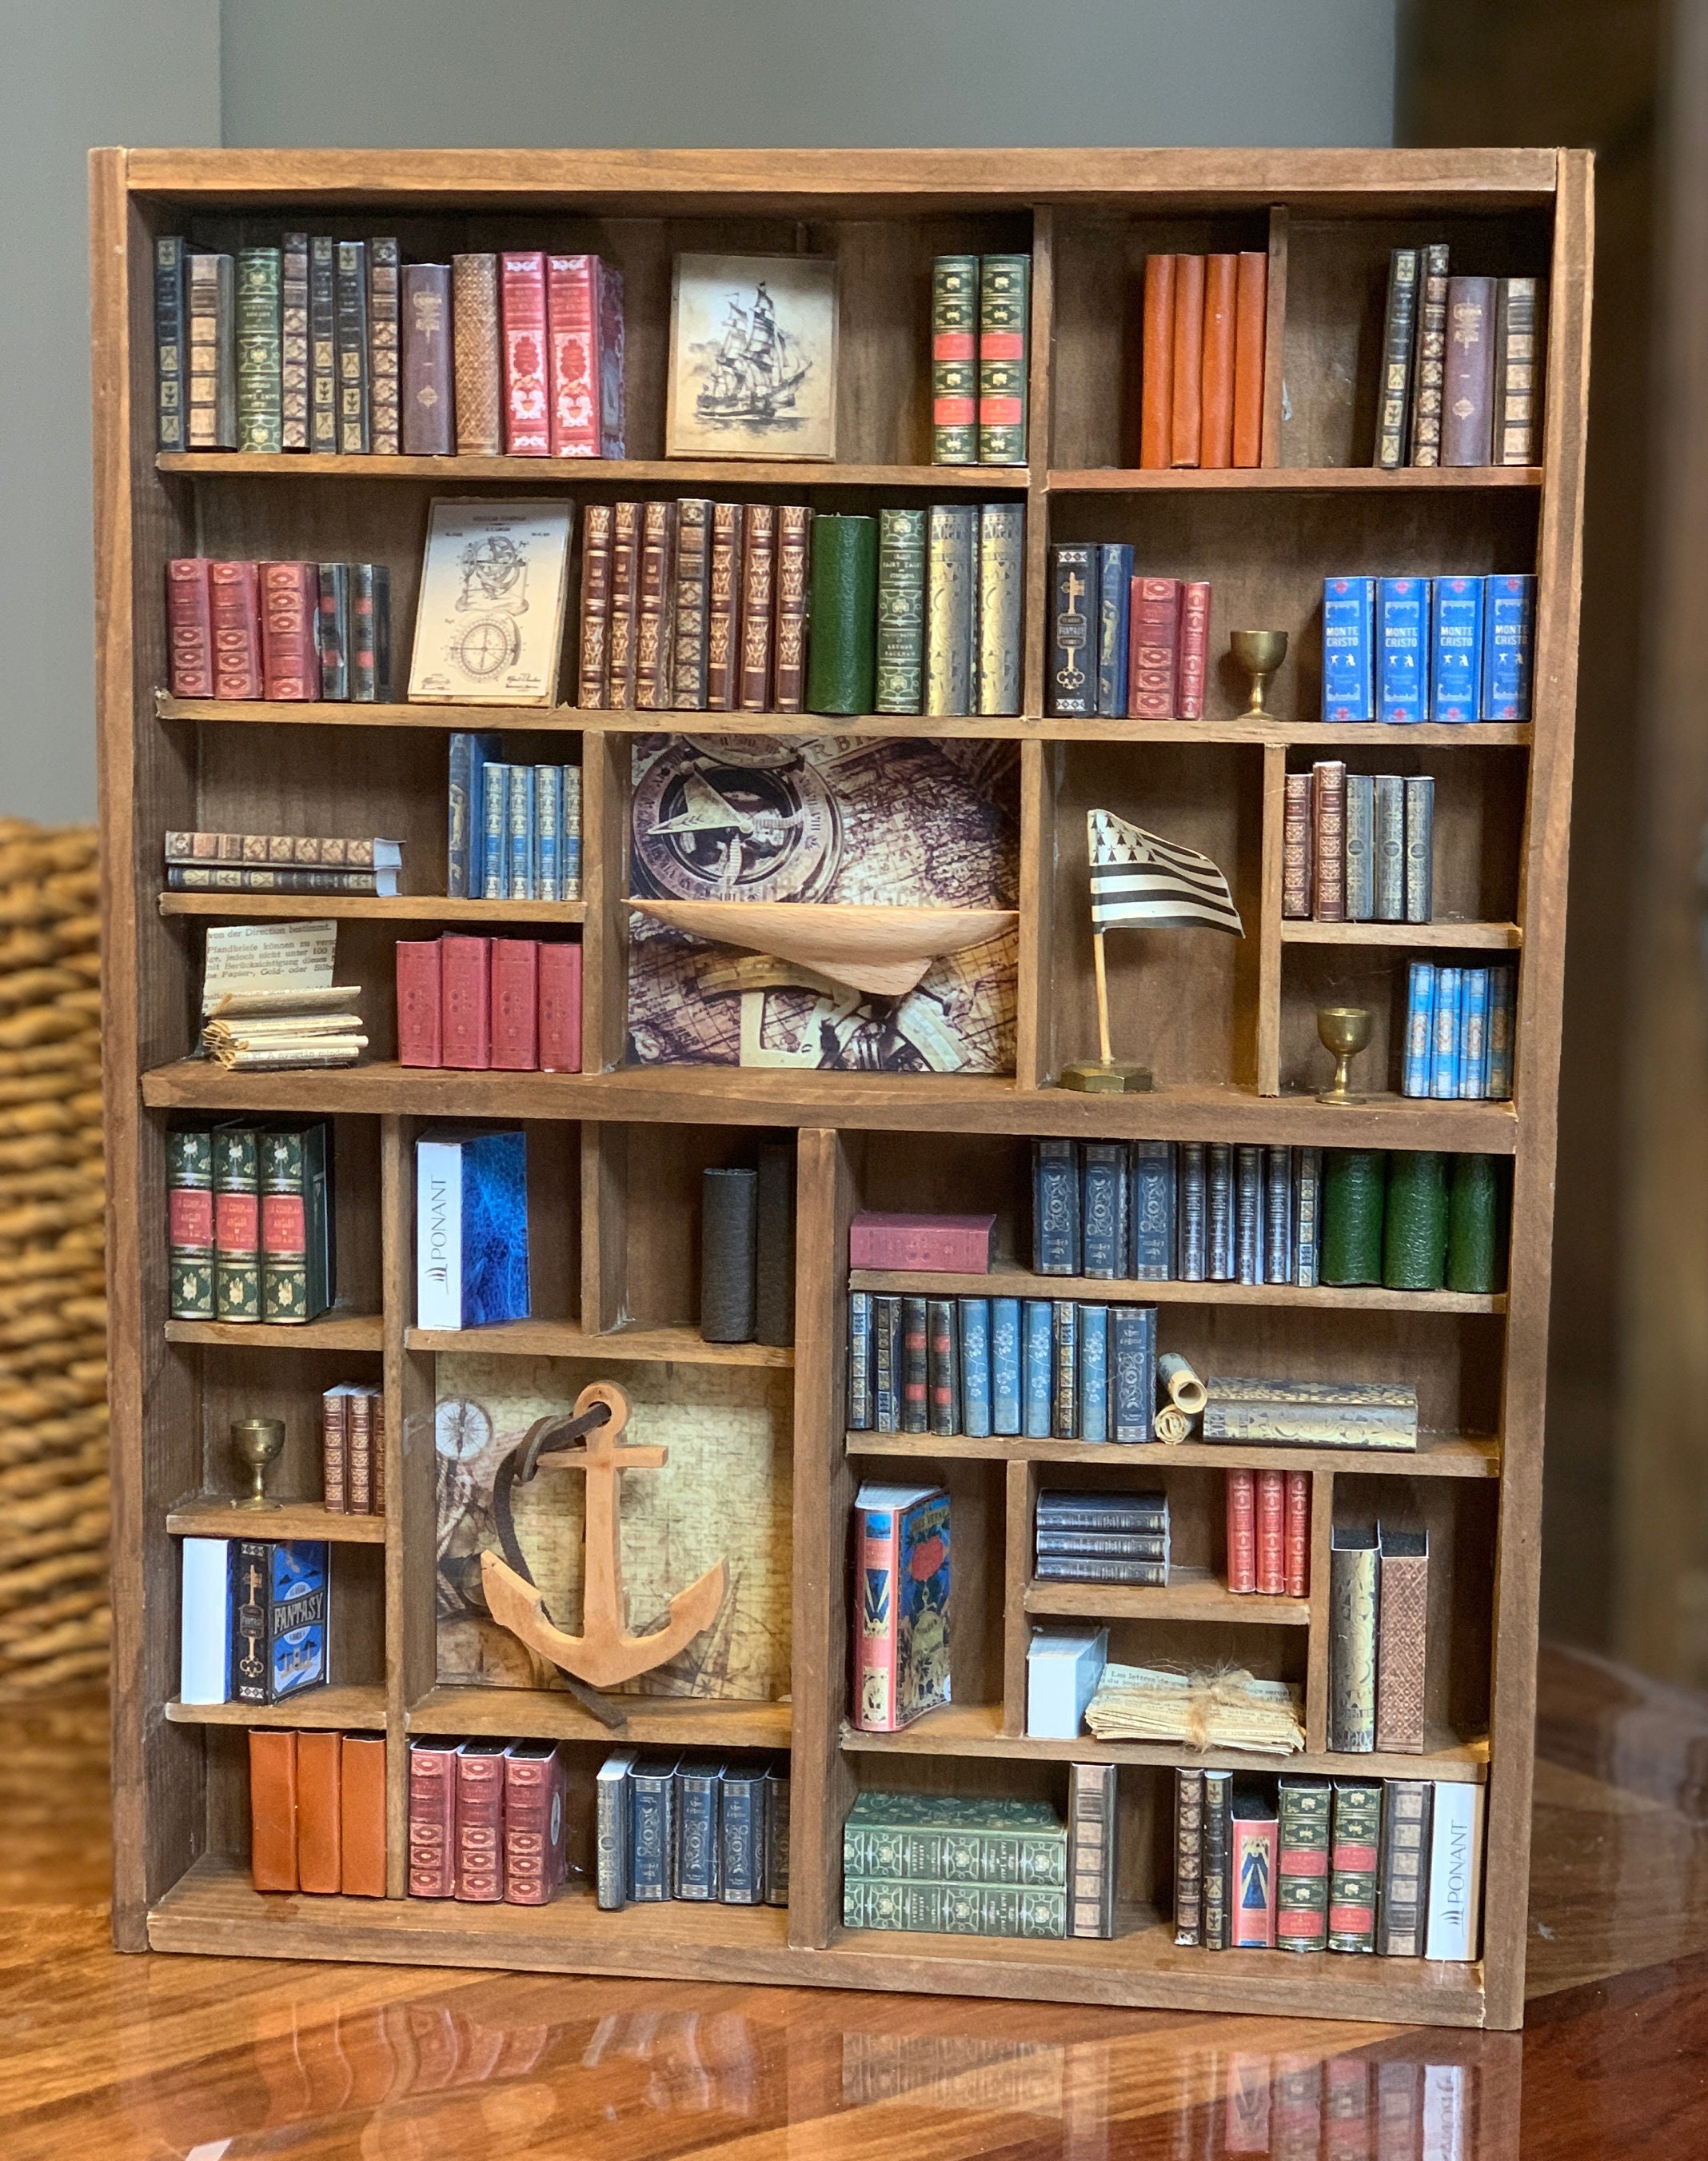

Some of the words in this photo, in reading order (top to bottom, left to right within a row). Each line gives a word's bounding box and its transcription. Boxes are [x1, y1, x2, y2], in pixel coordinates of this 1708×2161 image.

[1326, 626, 1359, 637] MONTE
[1385, 626, 1419, 637] MONTE
[1440, 626, 1474, 637] MONTE
[1494, 625, 1530, 636] MONTE
[1326, 637, 1359, 648] CRISTO
[1385, 637, 1418, 648] CRISTO
[1440, 637, 1473, 648] CRISTO
[1494, 635, 1529, 646] CRISTO
[227, 929, 242, 938] der
[245, 927, 285, 937] Direction
[207, 944, 258, 953] Pfandbriefe
[225, 953, 254, 962] jedoch
[224, 959, 299, 970] Berücksichtigung
[430, 1173, 448, 1260] PONANT
[274, 1592, 323, 1635] FANTASY
[1129, 1673, 1156, 1683] lettres
[1447, 1819, 1469, 1904] PONANT
